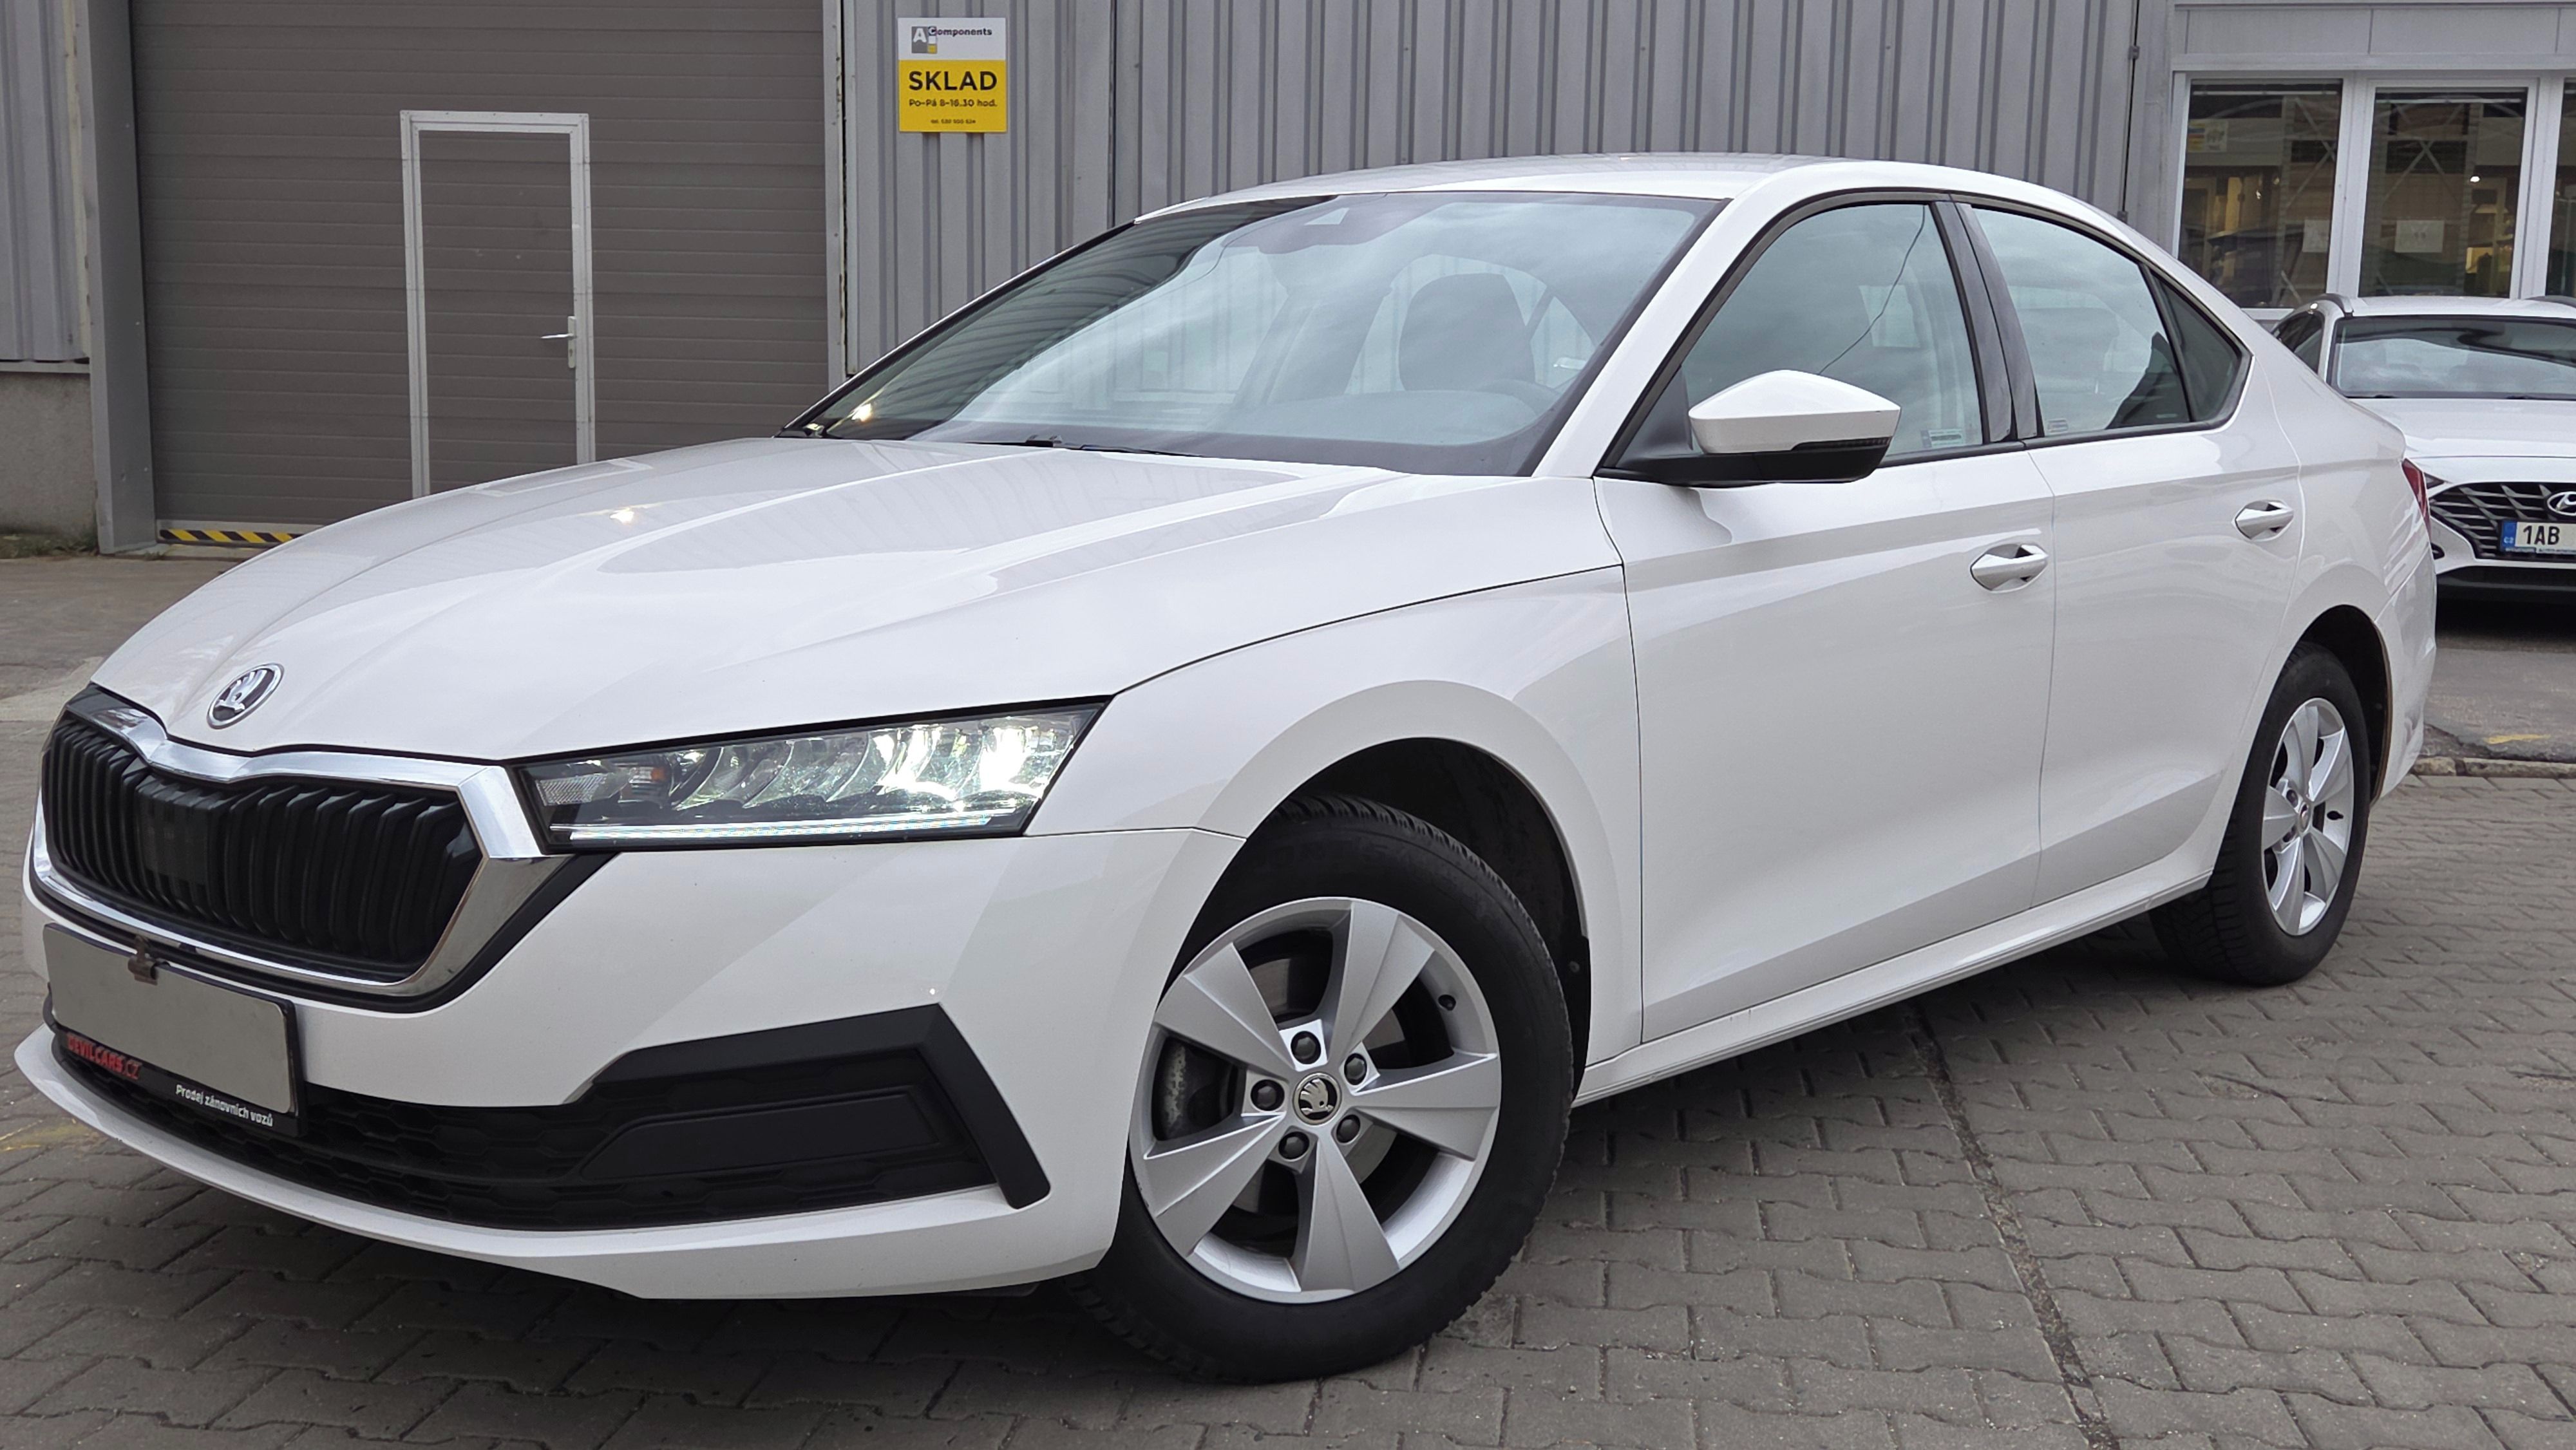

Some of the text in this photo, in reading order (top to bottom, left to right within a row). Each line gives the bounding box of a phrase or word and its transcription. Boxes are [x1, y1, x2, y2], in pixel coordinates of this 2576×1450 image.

[928, 26, 992, 37] Components
[909, 71, 998, 90] SKLAD
[977, 99, 998, 107] hod.
[2523, 525, 2560, 545] 1AB
[176, 1084, 273, 1127] Prodej zánovních vozů
